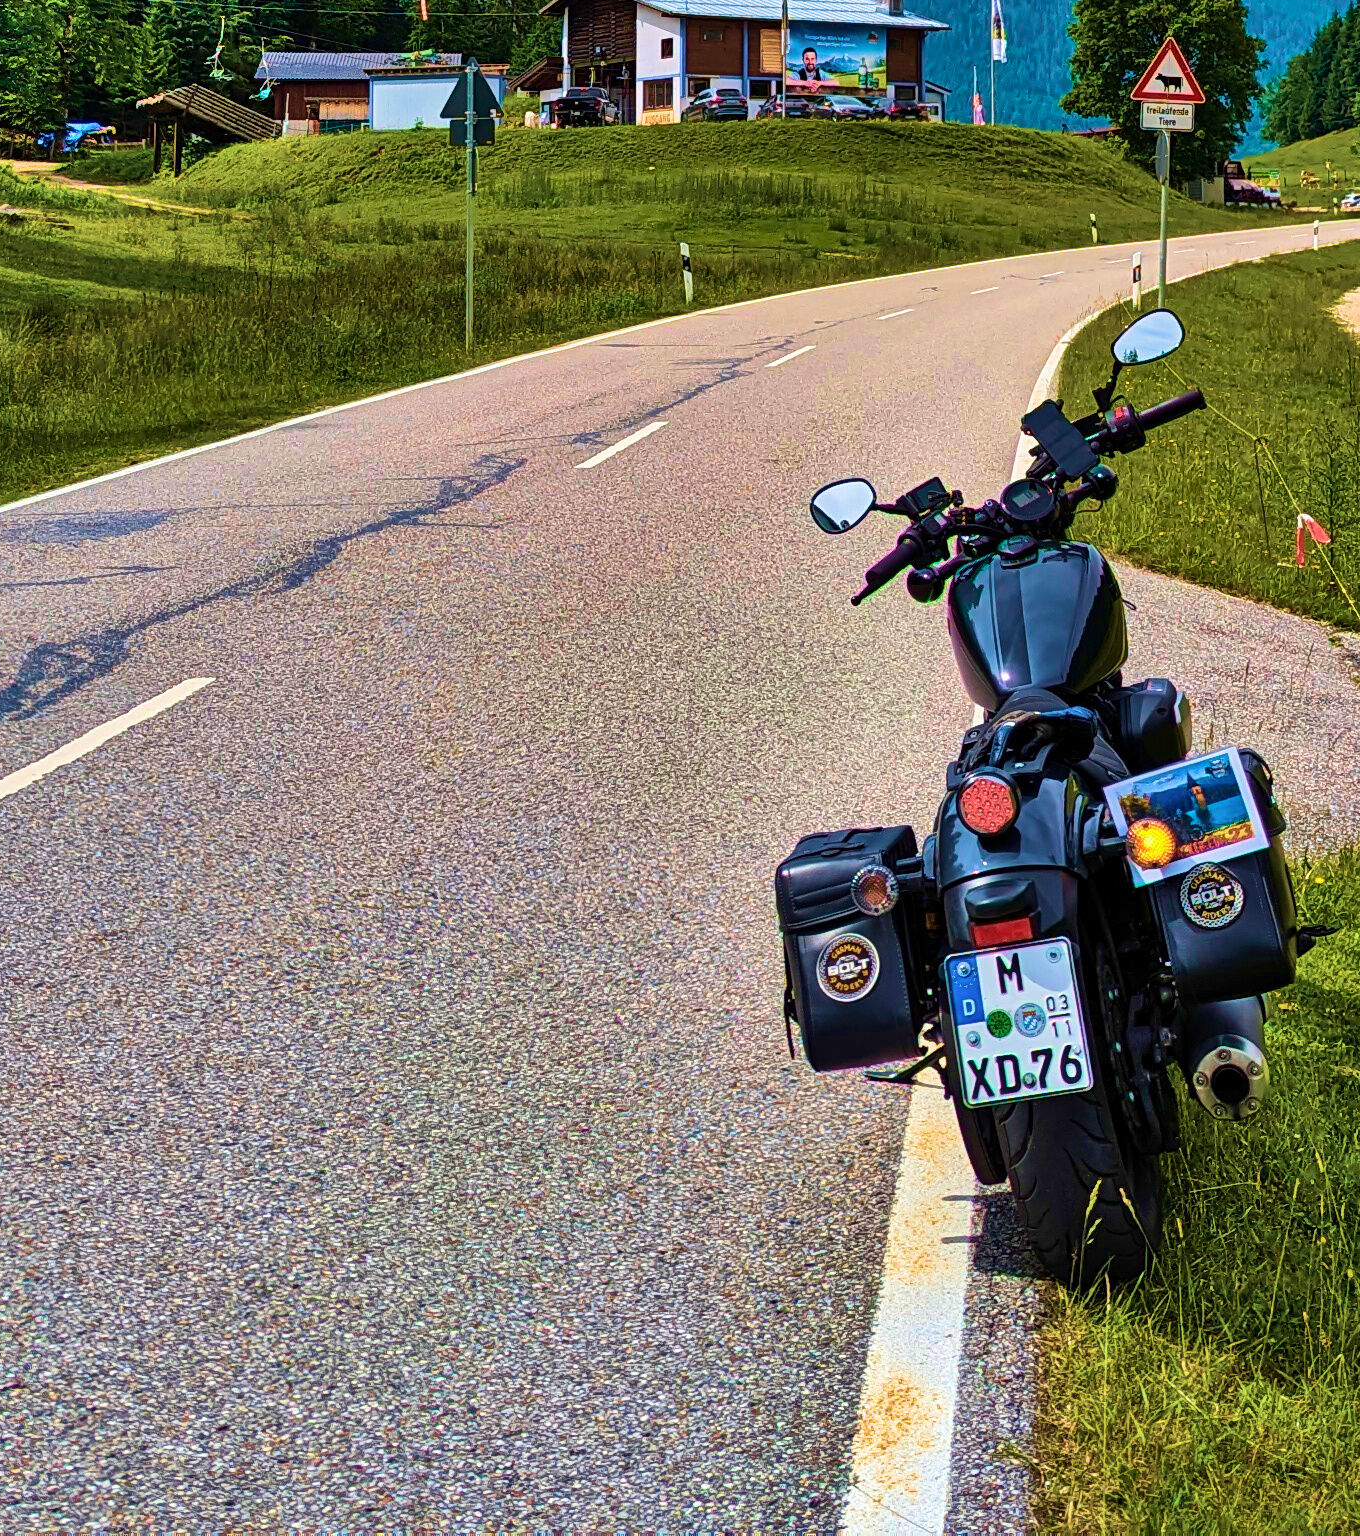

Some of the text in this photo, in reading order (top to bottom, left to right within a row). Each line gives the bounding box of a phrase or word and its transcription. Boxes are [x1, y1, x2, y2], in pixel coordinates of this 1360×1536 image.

[1159, 117, 1176, 126] Tiere
[1191, 871, 1225, 889] GERMAN
[1190, 885, 1232, 906] BOLT
[1202, 904, 1231, 920] RIDERS
[831, 944, 862, 959] GERMAN
[827, 958, 870, 977] BOLT
[995, 953, 1024, 994] M
[962, 999, 976, 1016] D
[1046, 994, 1069, 1011] 03
[1051, 1020, 1072, 1038] 11
